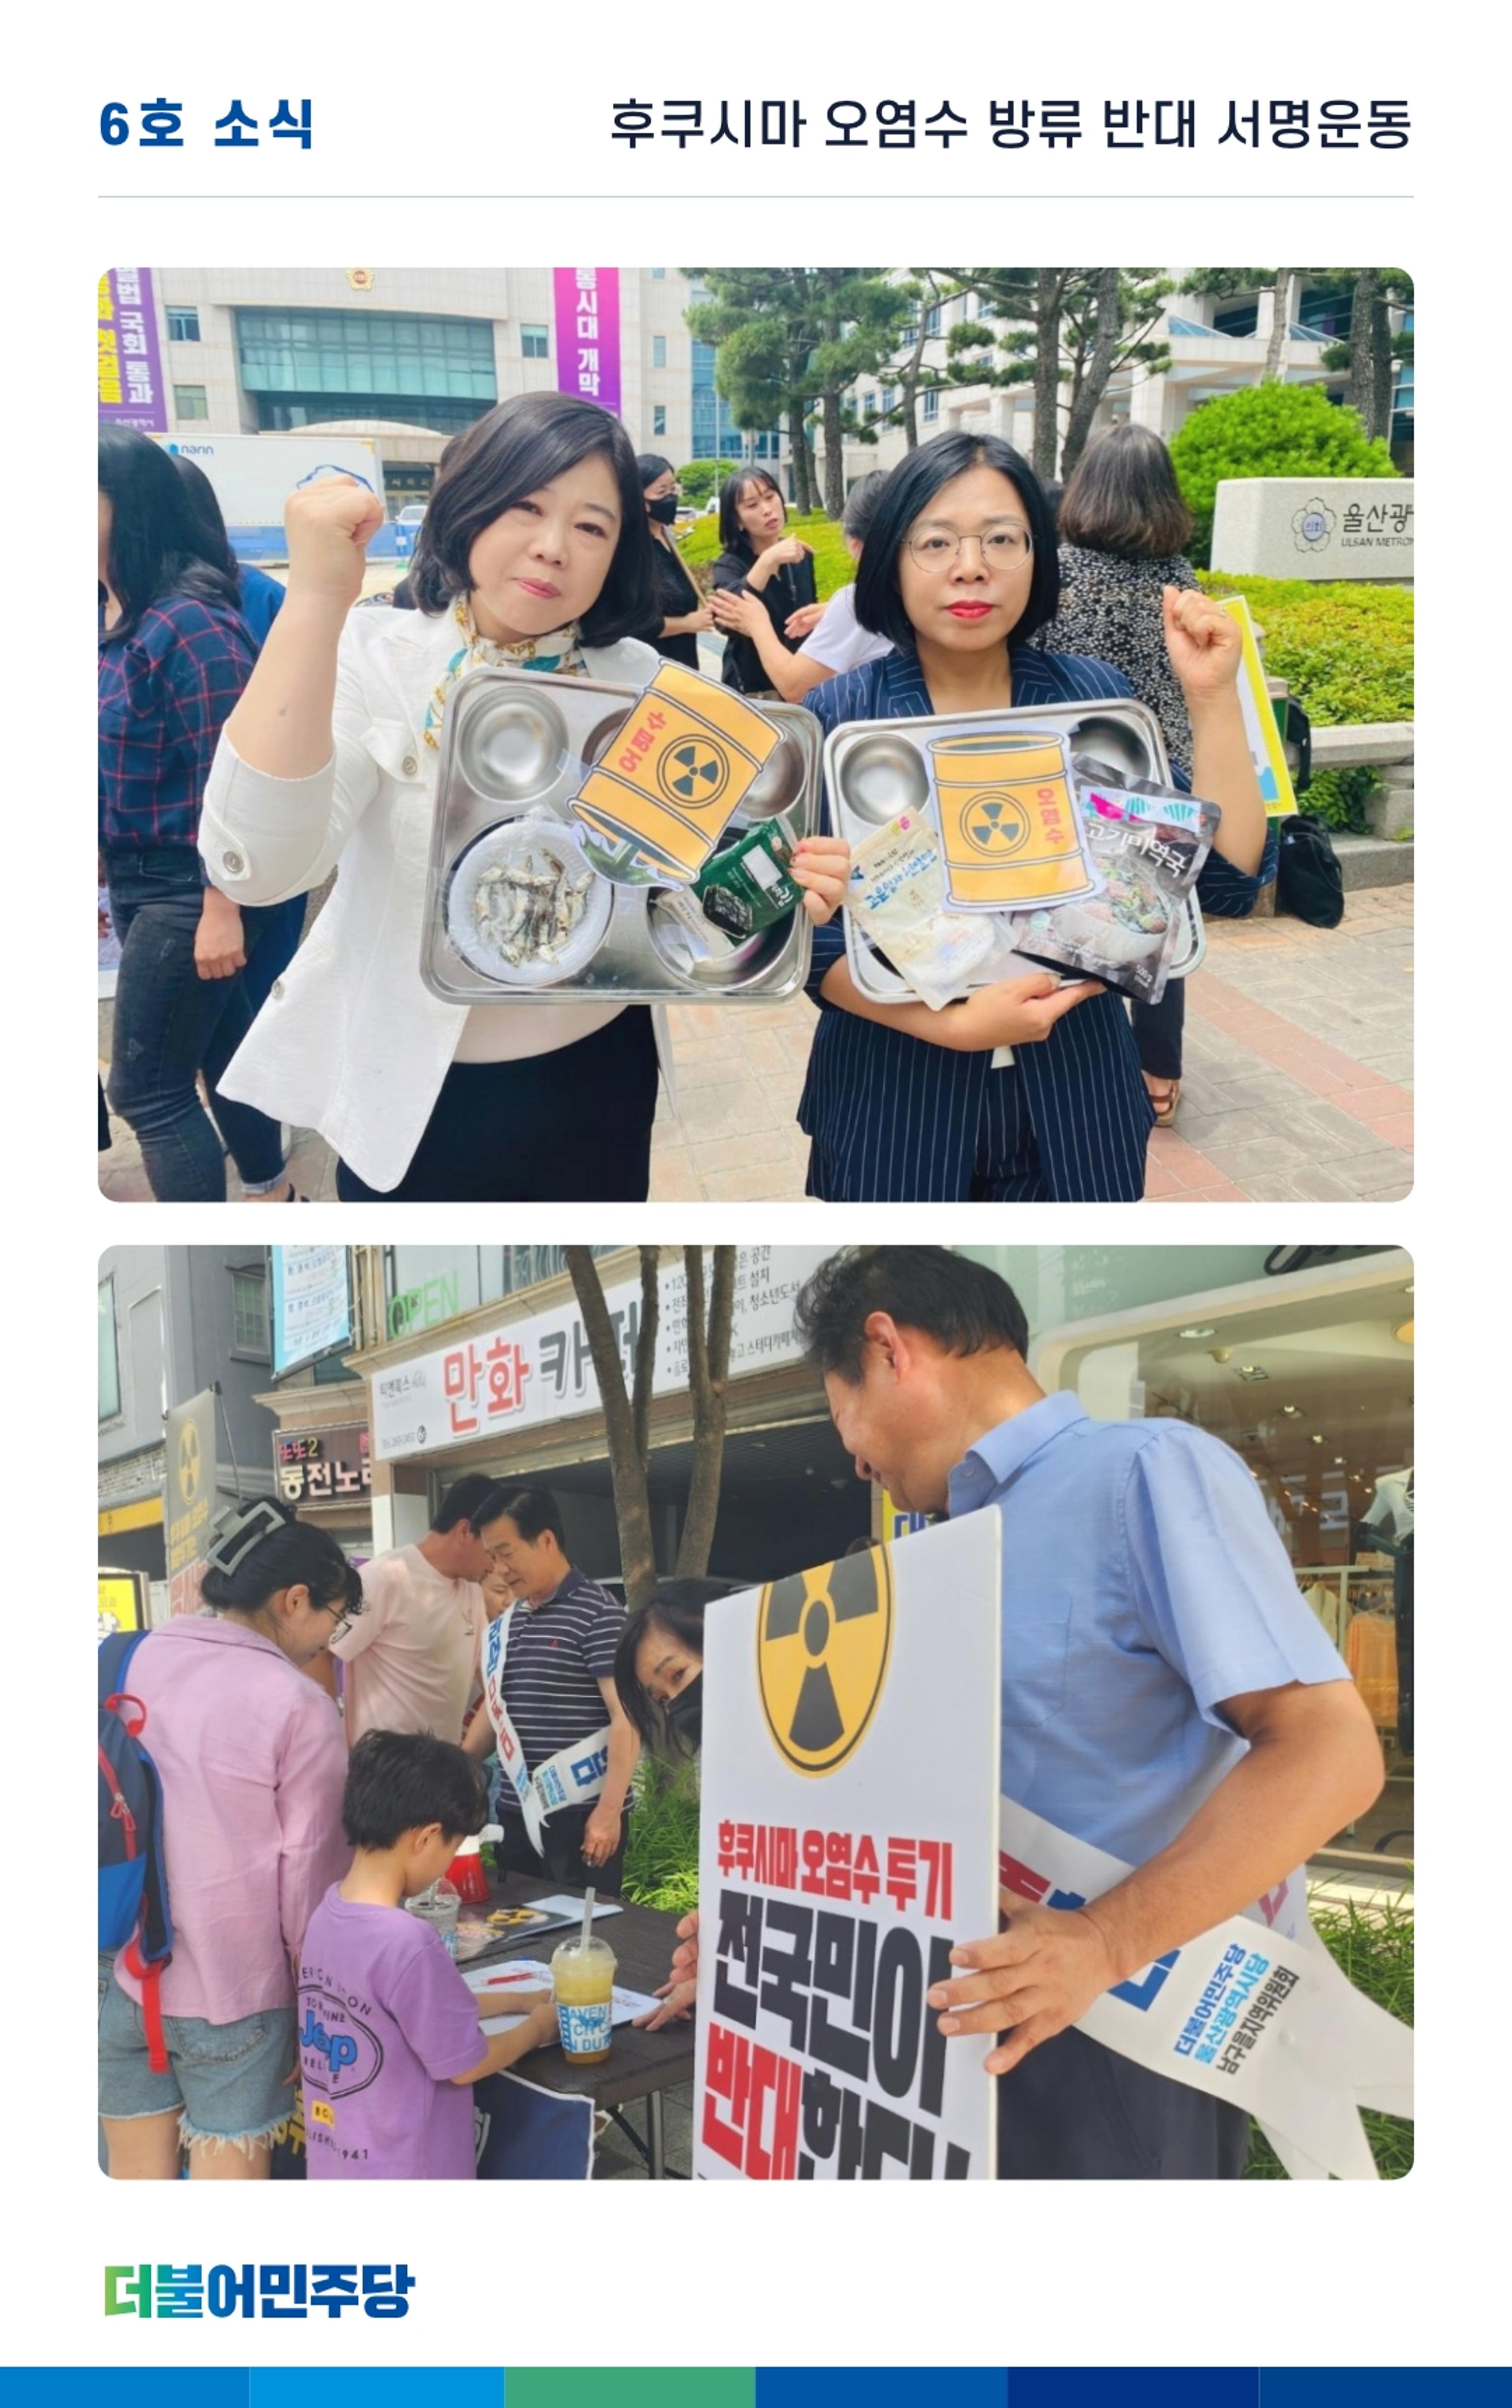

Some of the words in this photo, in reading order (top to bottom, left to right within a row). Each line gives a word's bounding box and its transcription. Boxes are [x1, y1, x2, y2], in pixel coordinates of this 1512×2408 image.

[578, 348, 600, 397] 개막
[1341, 537, 1373, 547] ULSAN
[619, 711, 666, 772] 오염수
[1036, 787, 1068, 845] 오염수
[1086, 823, 1193, 878] 고기미역국
[389, 1270, 459, 1339] OPEN
[444, 1337, 529, 1433] 만화
[718, 1819, 798, 1890] 후쿠시마
[801, 1829, 880, 1905] 오염수
[887, 1837, 953, 1921] 투기
[713, 1888, 954, 2119] 전국민이
[1173, 1943, 1247, 2056] 더불어민주당
[1194, 1953, 1270, 2064] 울산광역시당
[1216, 1965, 1300, 2075] 남구을지역위원회
[702, 2021, 971, 2180] 반대한다
